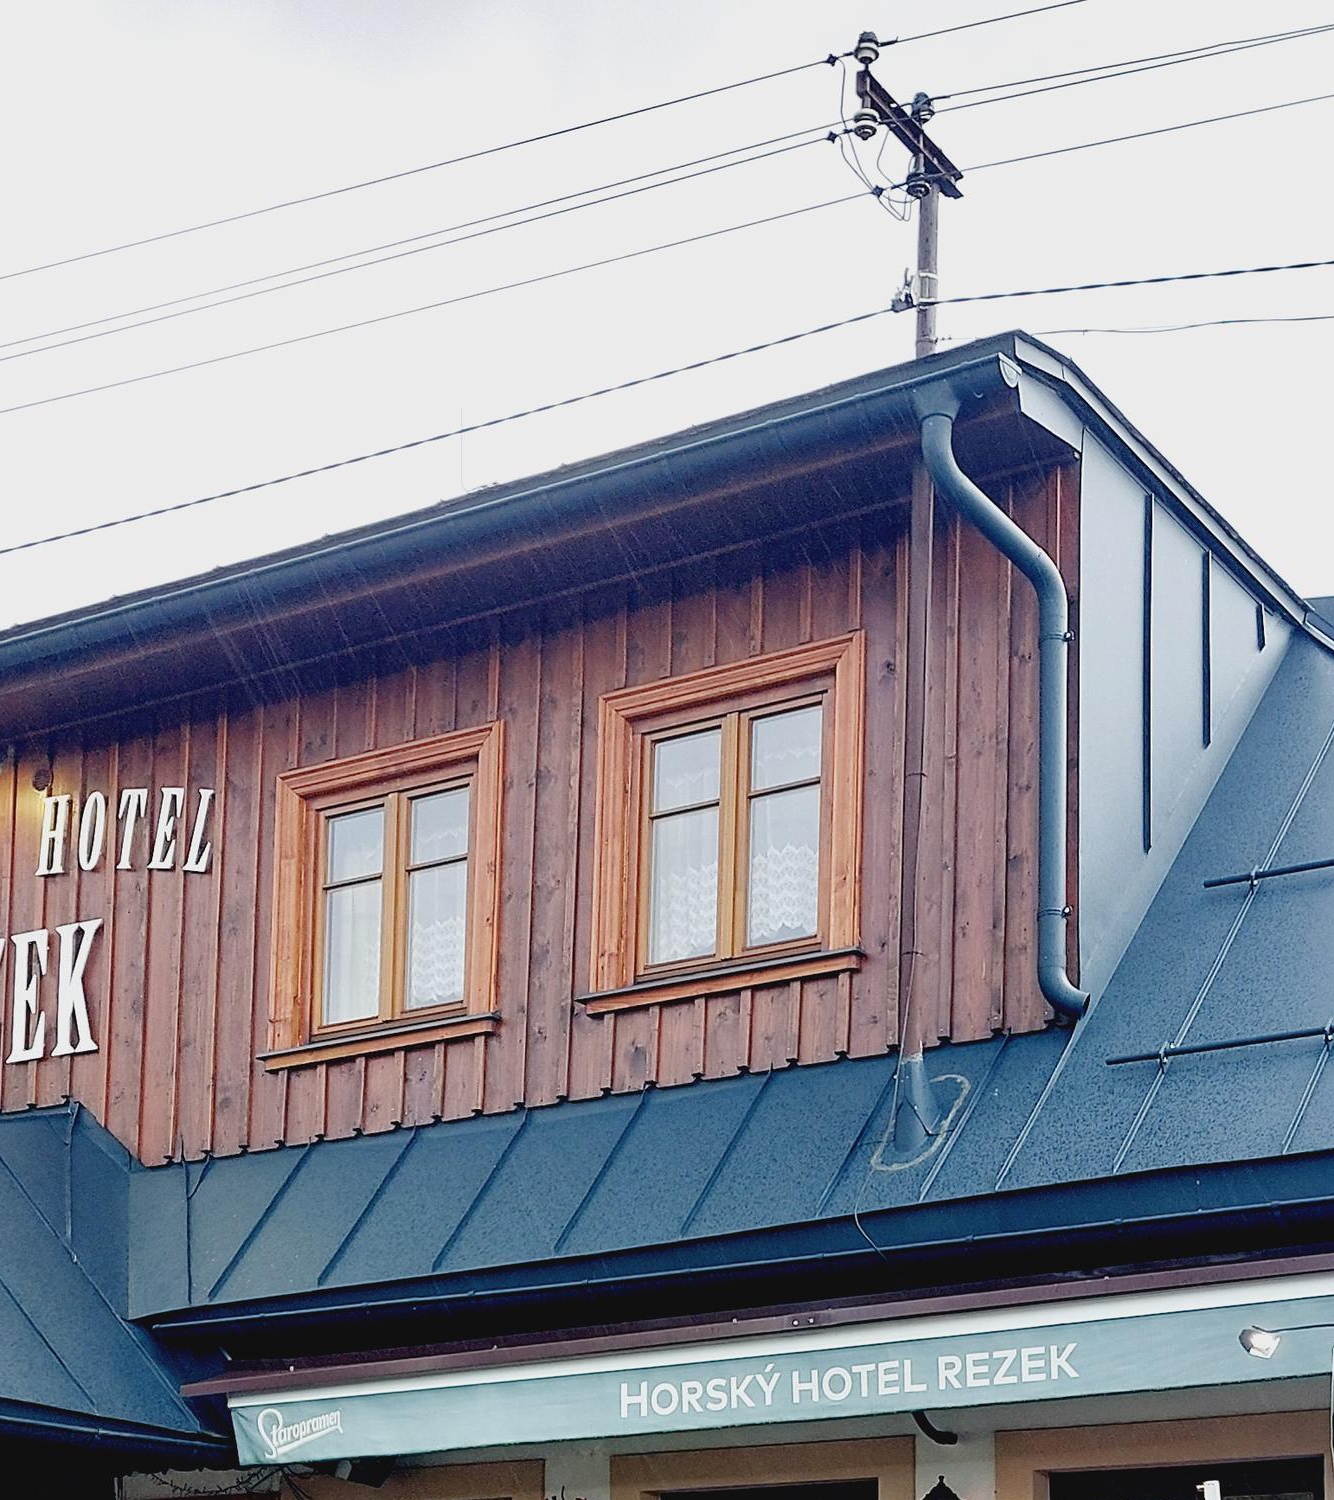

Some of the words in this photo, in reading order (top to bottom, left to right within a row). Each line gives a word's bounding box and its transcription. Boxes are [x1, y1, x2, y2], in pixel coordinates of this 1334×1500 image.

[36, 787, 214, 876] HOTEL
[620, 1364, 781, 1418] HORSKÝ
[792, 1359, 927, 1404] HOTEL
[938, 1342, 1079, 1391] REZEK
[257, 1407, 343, 1458] Staropramen
